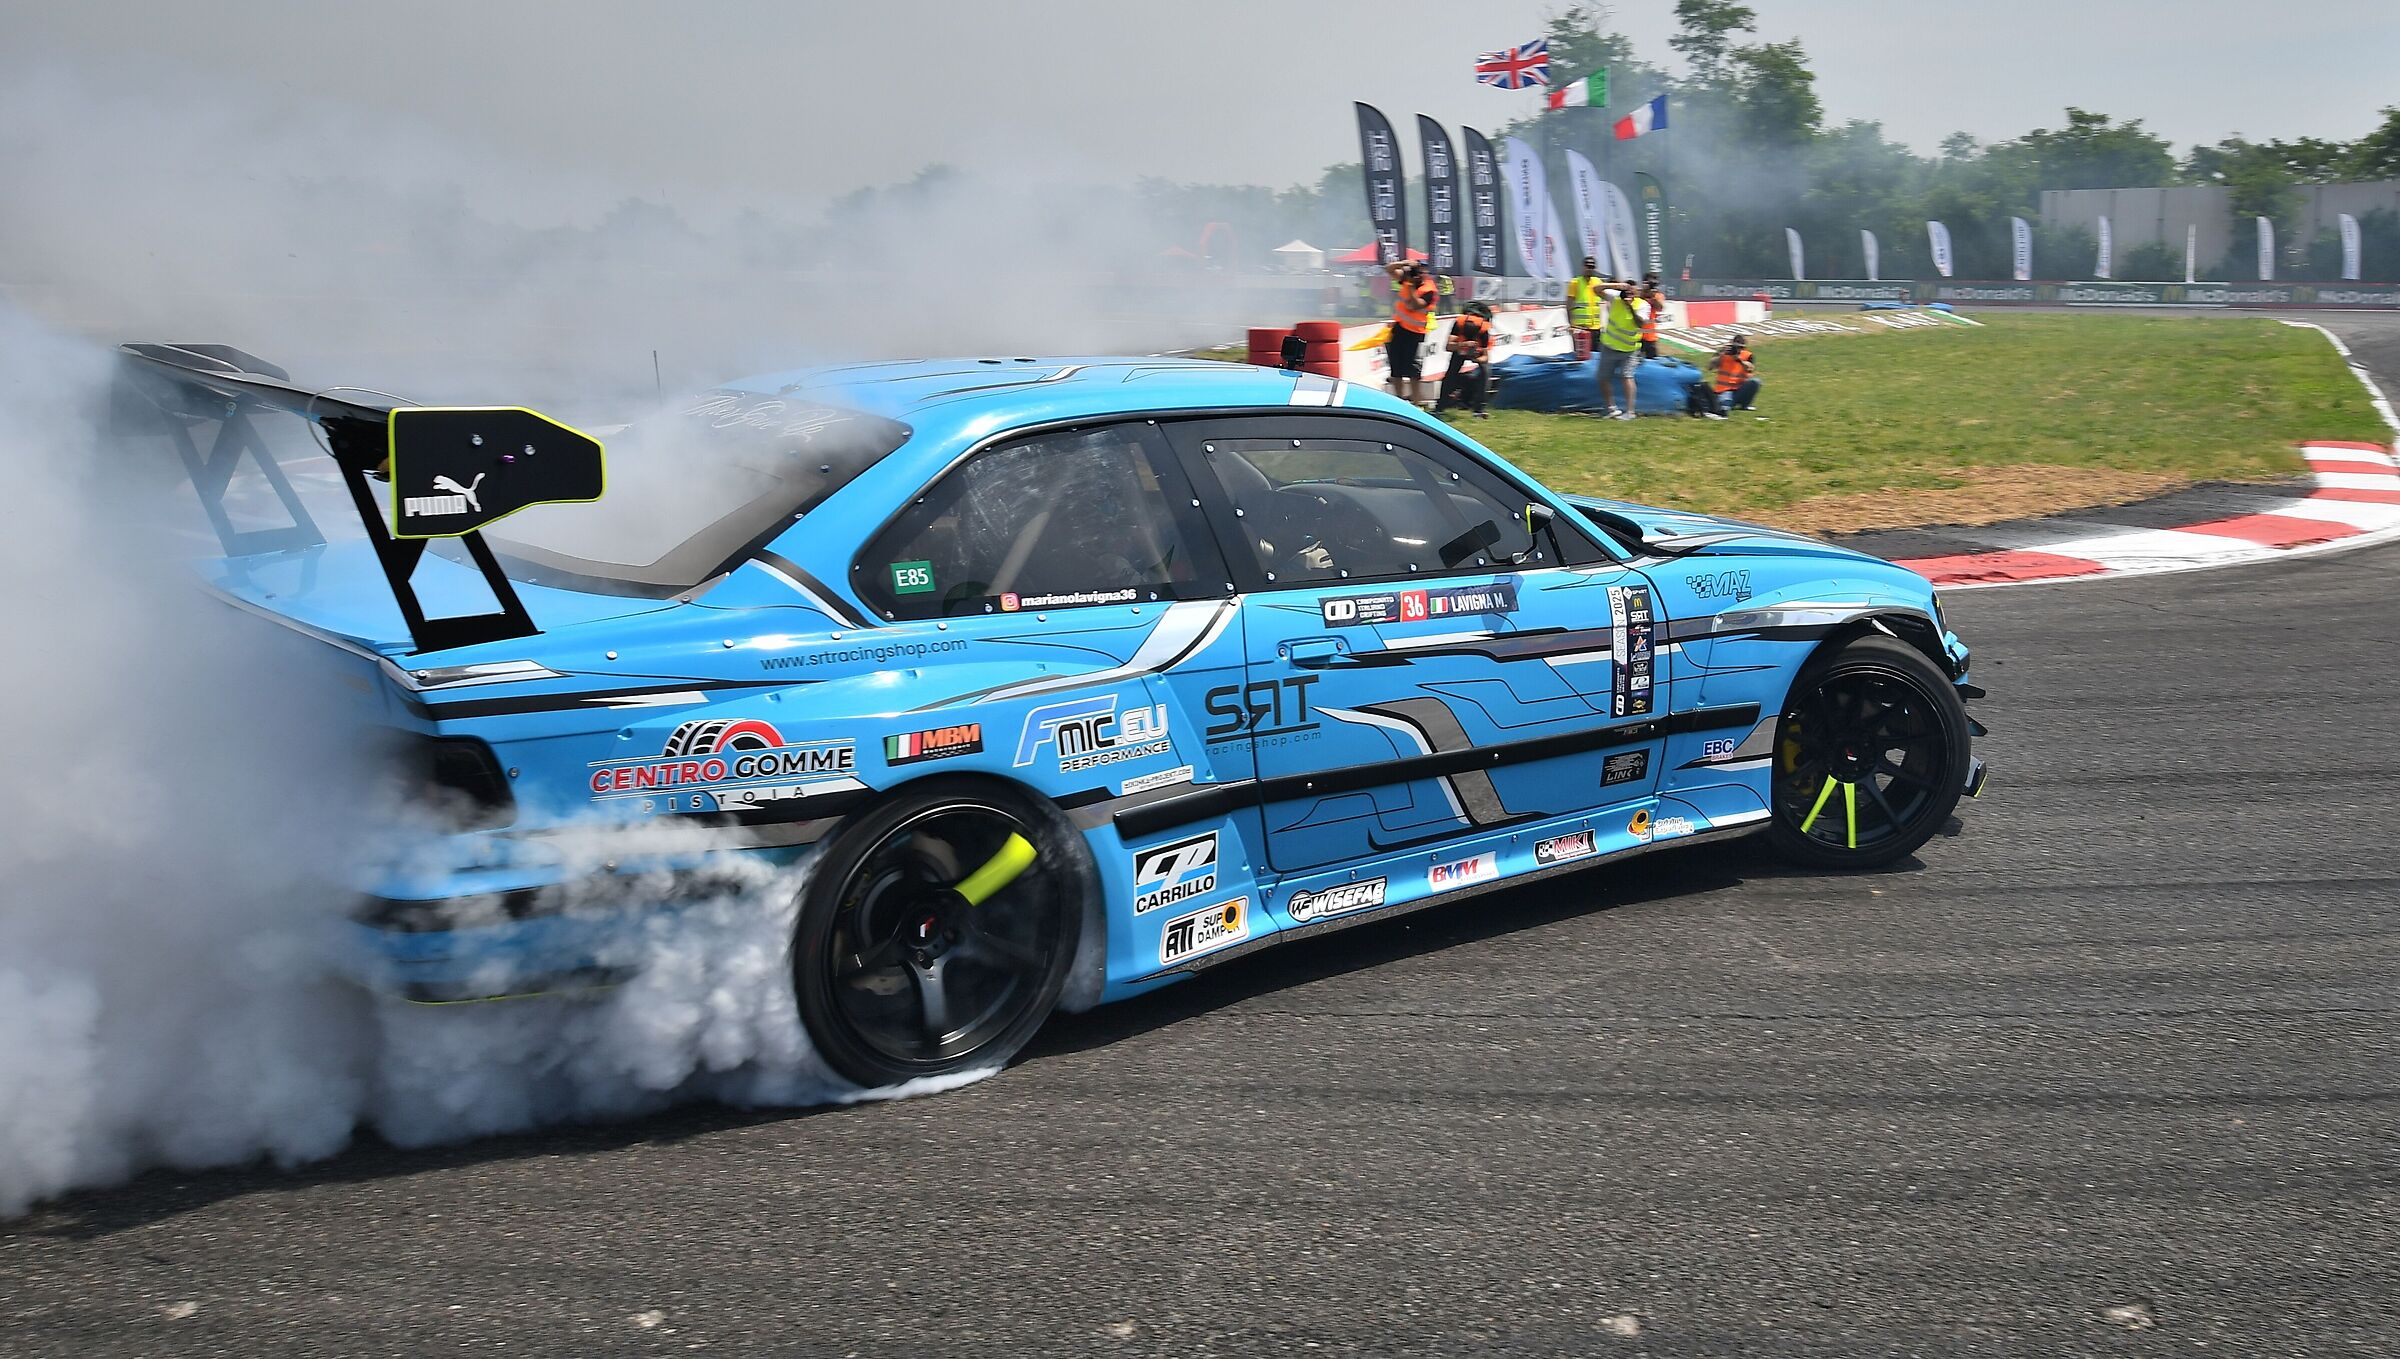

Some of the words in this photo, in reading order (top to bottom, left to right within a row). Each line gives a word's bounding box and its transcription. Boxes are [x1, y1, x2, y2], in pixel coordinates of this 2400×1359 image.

[404, 494, 468, 517] PUMA
[895, 567, 930, 588] E85
[1021, 588, 1137, 608] marianolavigna36
[1403, 595, 1425, 618] 36
[1450, 593, 1493, 613] LAVIGNA
[1492, 592, 1508, 609] M.
[1610, 589, 1625, 615] 2025
[760, 637, 968, 671] www.srtracingshop.com
[922, 723, 980, 750] MBM
[1205, 731, 1322, 756] racingshop.com
[1703, 740, 1733, 756] EBC
[589, 758, 729, 795] CENTRO
[735, 744, 856, 778] GOMME
[1060, 741, 1170, 773] PERFORMANCE
[643, 785, 807, 815] PISTOIA
[1553, 832, 1590, 855] MIKI
[1432, 858, 1479, 884] BMM
[1135, 875, 1216, 913] CARRILLO
[1312, 882, 1386, 914] WISEFAB
[1165, 919, 1195, 960] ATI
